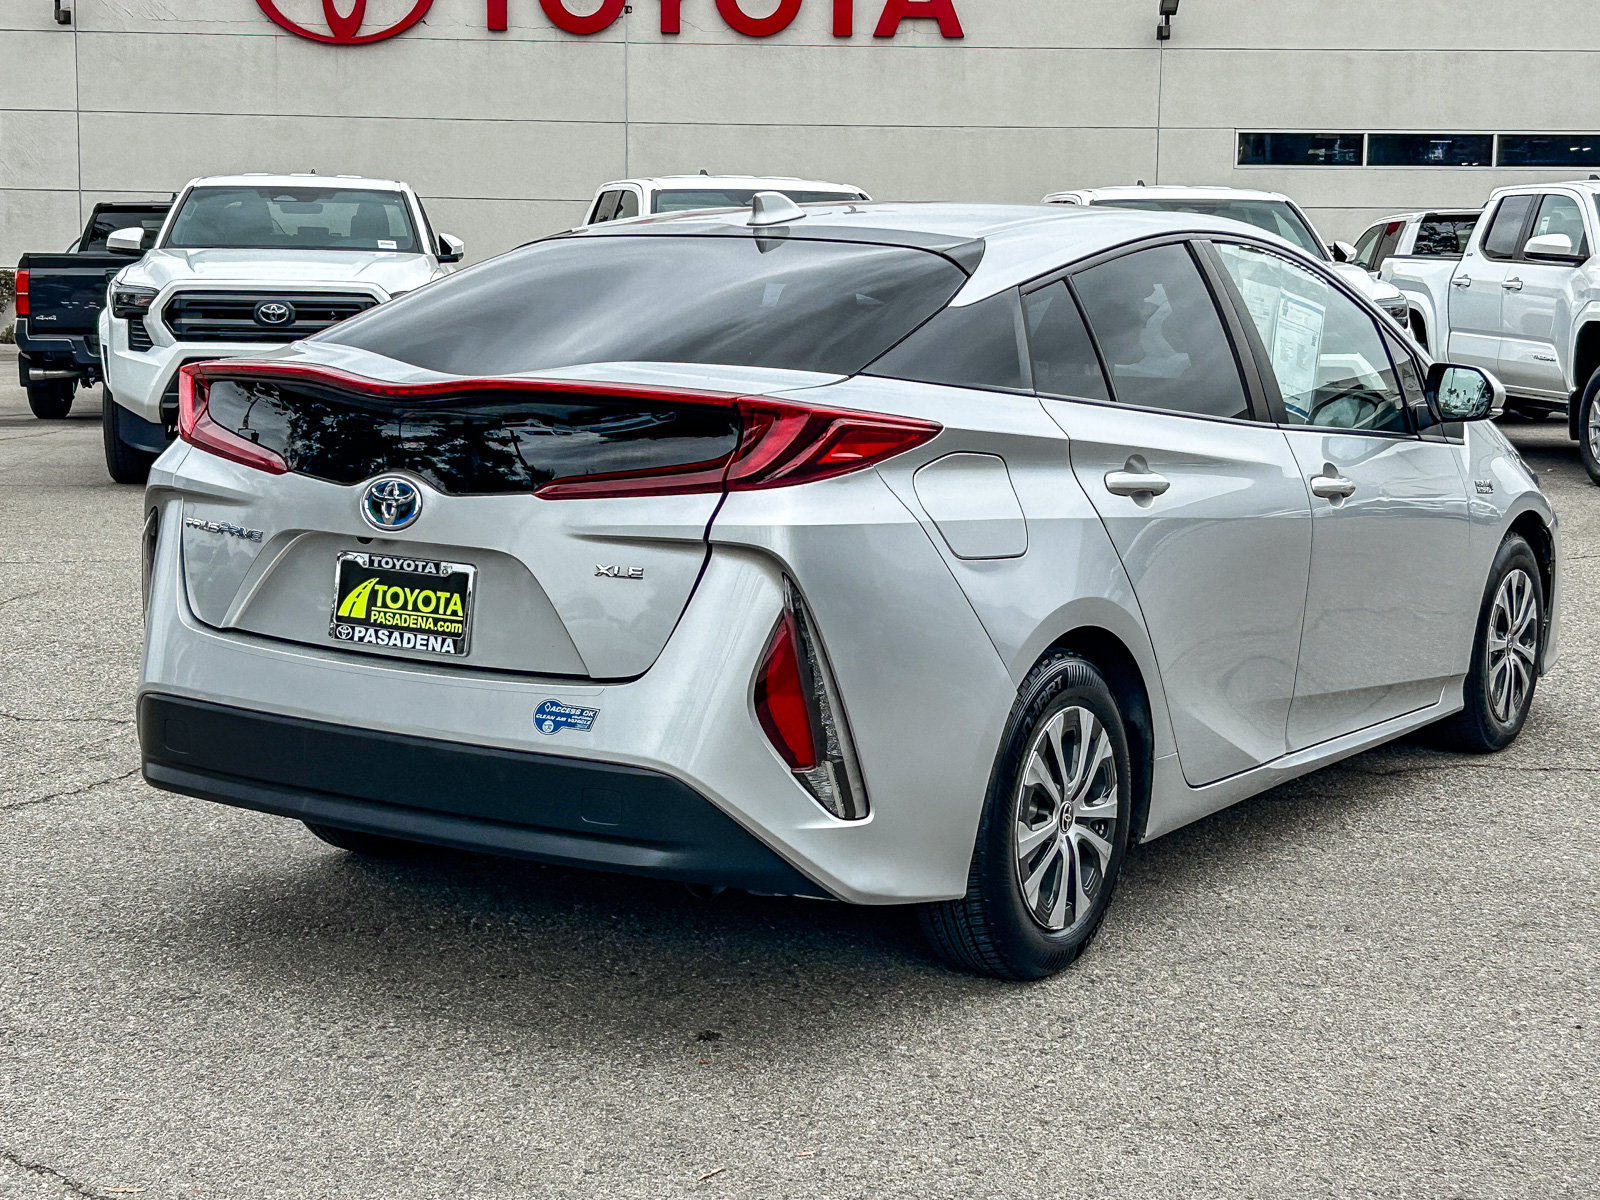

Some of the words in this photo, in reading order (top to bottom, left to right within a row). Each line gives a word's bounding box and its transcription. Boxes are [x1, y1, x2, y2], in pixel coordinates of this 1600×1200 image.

[371, 556, 437, 574] TOYOTA
[594, 563, 644, 580] XLE
[374, 584, 464, 617] TOYOTA
[370, 611, 463, 634] PASADENA.com
[353, 627, 455, 654] PASADENA
[550, 706, 581, 715] ACCESS
